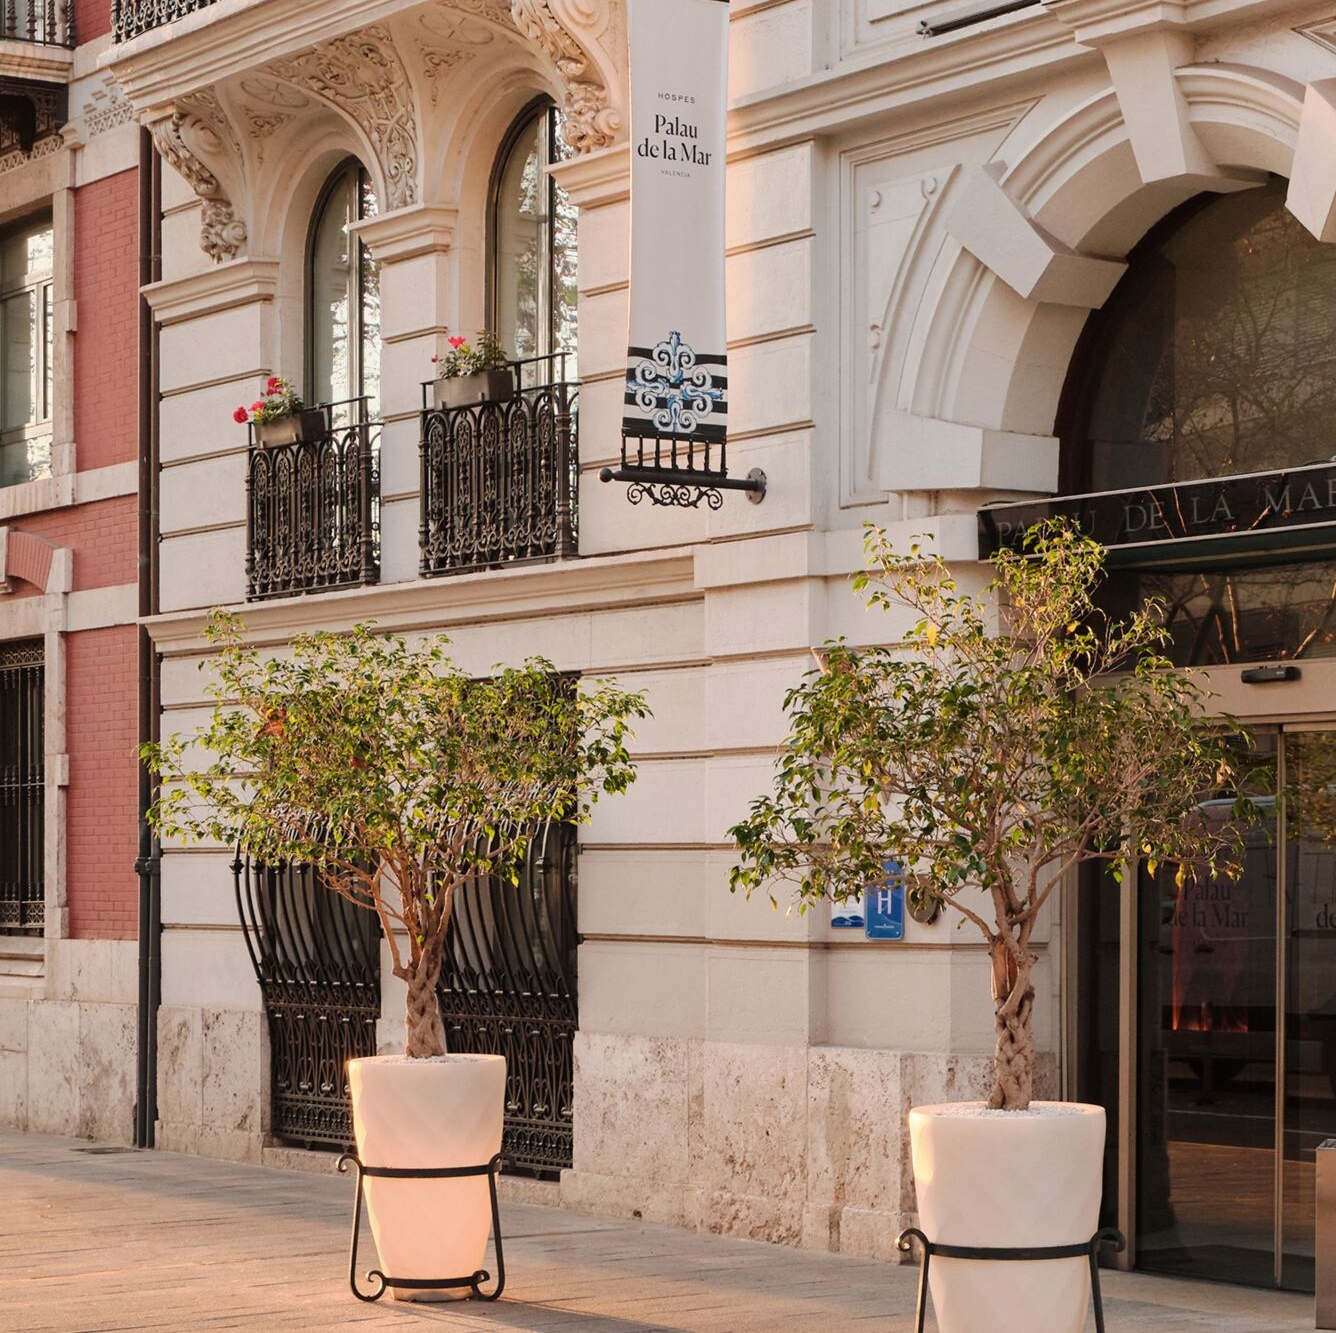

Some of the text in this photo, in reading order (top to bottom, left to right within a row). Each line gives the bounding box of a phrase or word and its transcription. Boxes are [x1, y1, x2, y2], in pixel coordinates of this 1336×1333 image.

[658, 92, 696, 104] HOSPES
[655, 114, 698, 139] Palau
[637, 138, 712, 166] de la Mar
[660, 169, 691, 178] VALENCIA
[996, 509, 1096, 547] PAU
[1124, 504, 1165, 533] DE
[1190, 495, 1235, 525] LA
[1183, 874, 1232, 901] Palau
[877, 888, 892, 915] H
[1192, 902, 1207, 927] la
[1211, 904, 1249, 928] Mar
